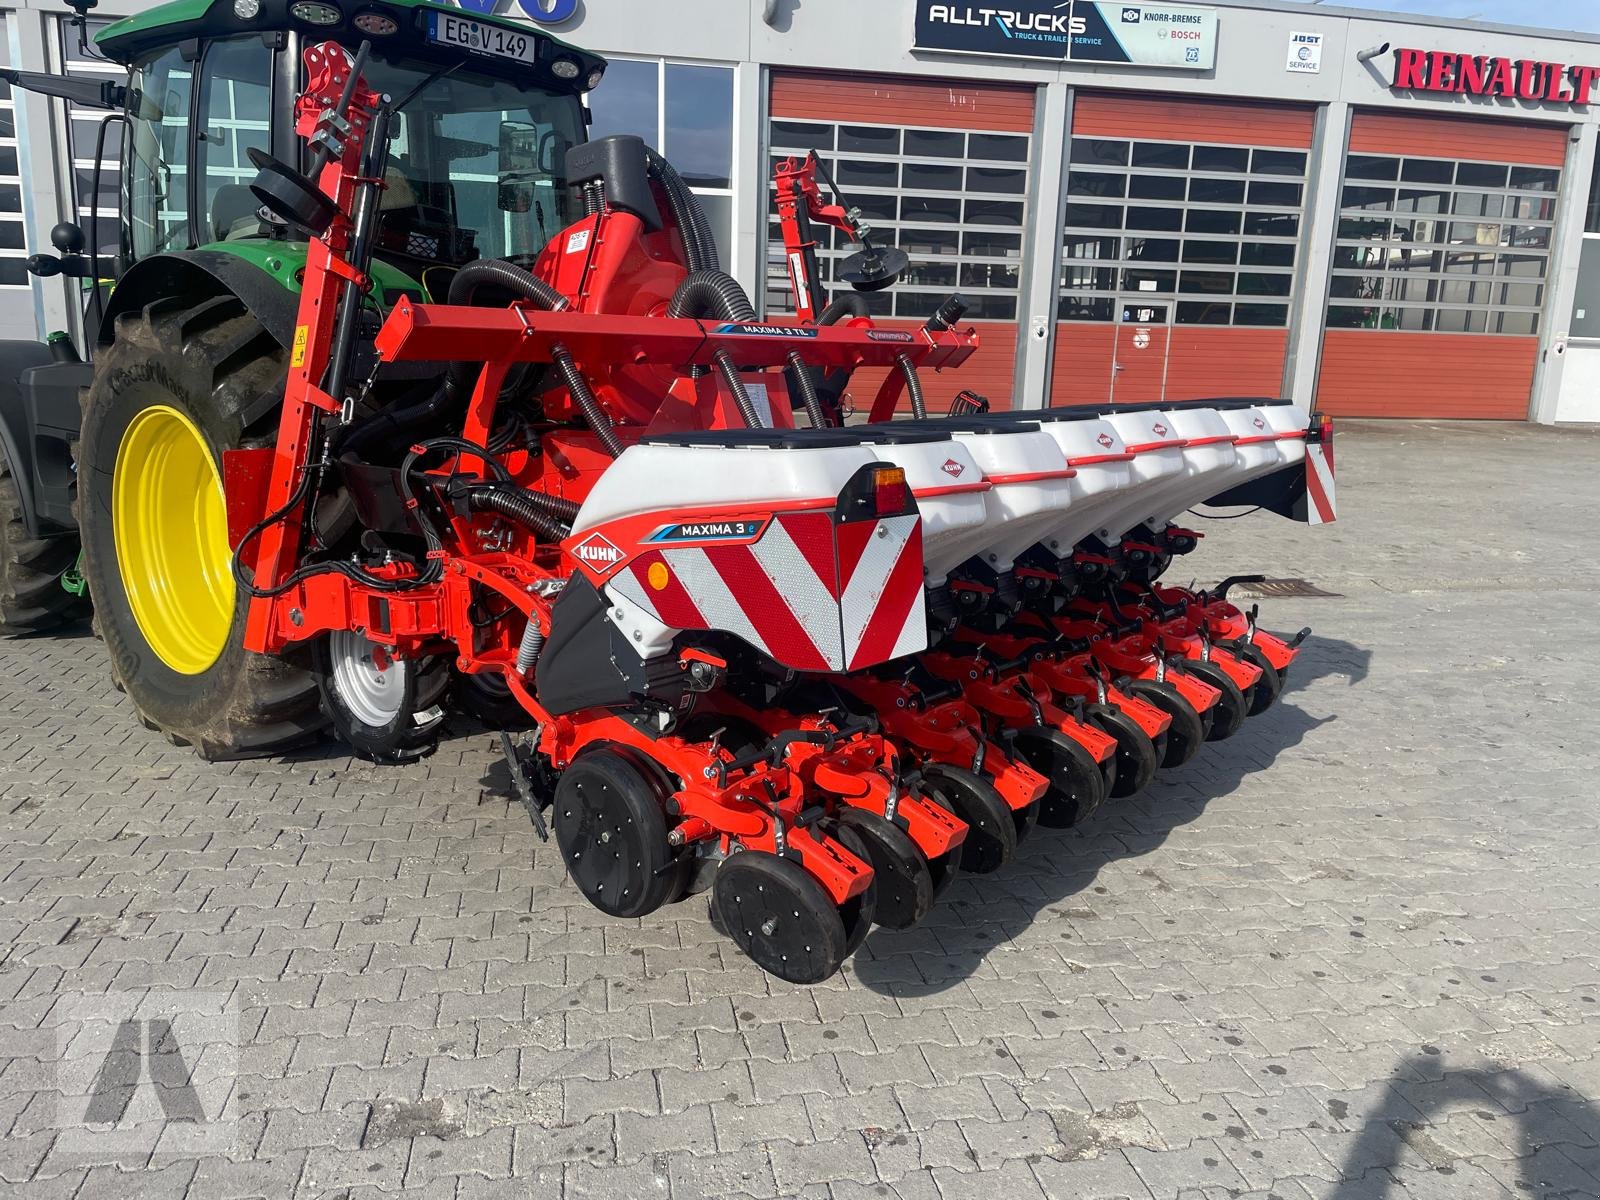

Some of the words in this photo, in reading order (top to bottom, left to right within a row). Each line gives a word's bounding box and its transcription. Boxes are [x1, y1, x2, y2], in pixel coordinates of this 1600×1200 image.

[929, 5, 1086, 37] ALLTRUCKS
[1144, 12, 1202, 24] KNORR-BREMSE
[445, 18, 469, 46] EG
[481, 27, 492, 49] V
[495, 32, 527, 58] 149
[1015, 32, 1038, 40] TRUCK
[1075, 37, 1102, 46] SERVICE
[1171, 31, 1200, 40] BOSCH
[1292, 35, 1320, 44] JOST
[1289, 61, 1317, 70] SERVICE
[1394, 48, 1600, 105] RENAULT
[743, 326, 784, 335] MAXIMA
[793, 328, 809, 336] TIL
[944, 463, 962, 472] KUHN
[682, 524, 732, 536] MAXIMA
[736, 524, 745, 534] 3
[579, 546, 617, 562] KUHN
